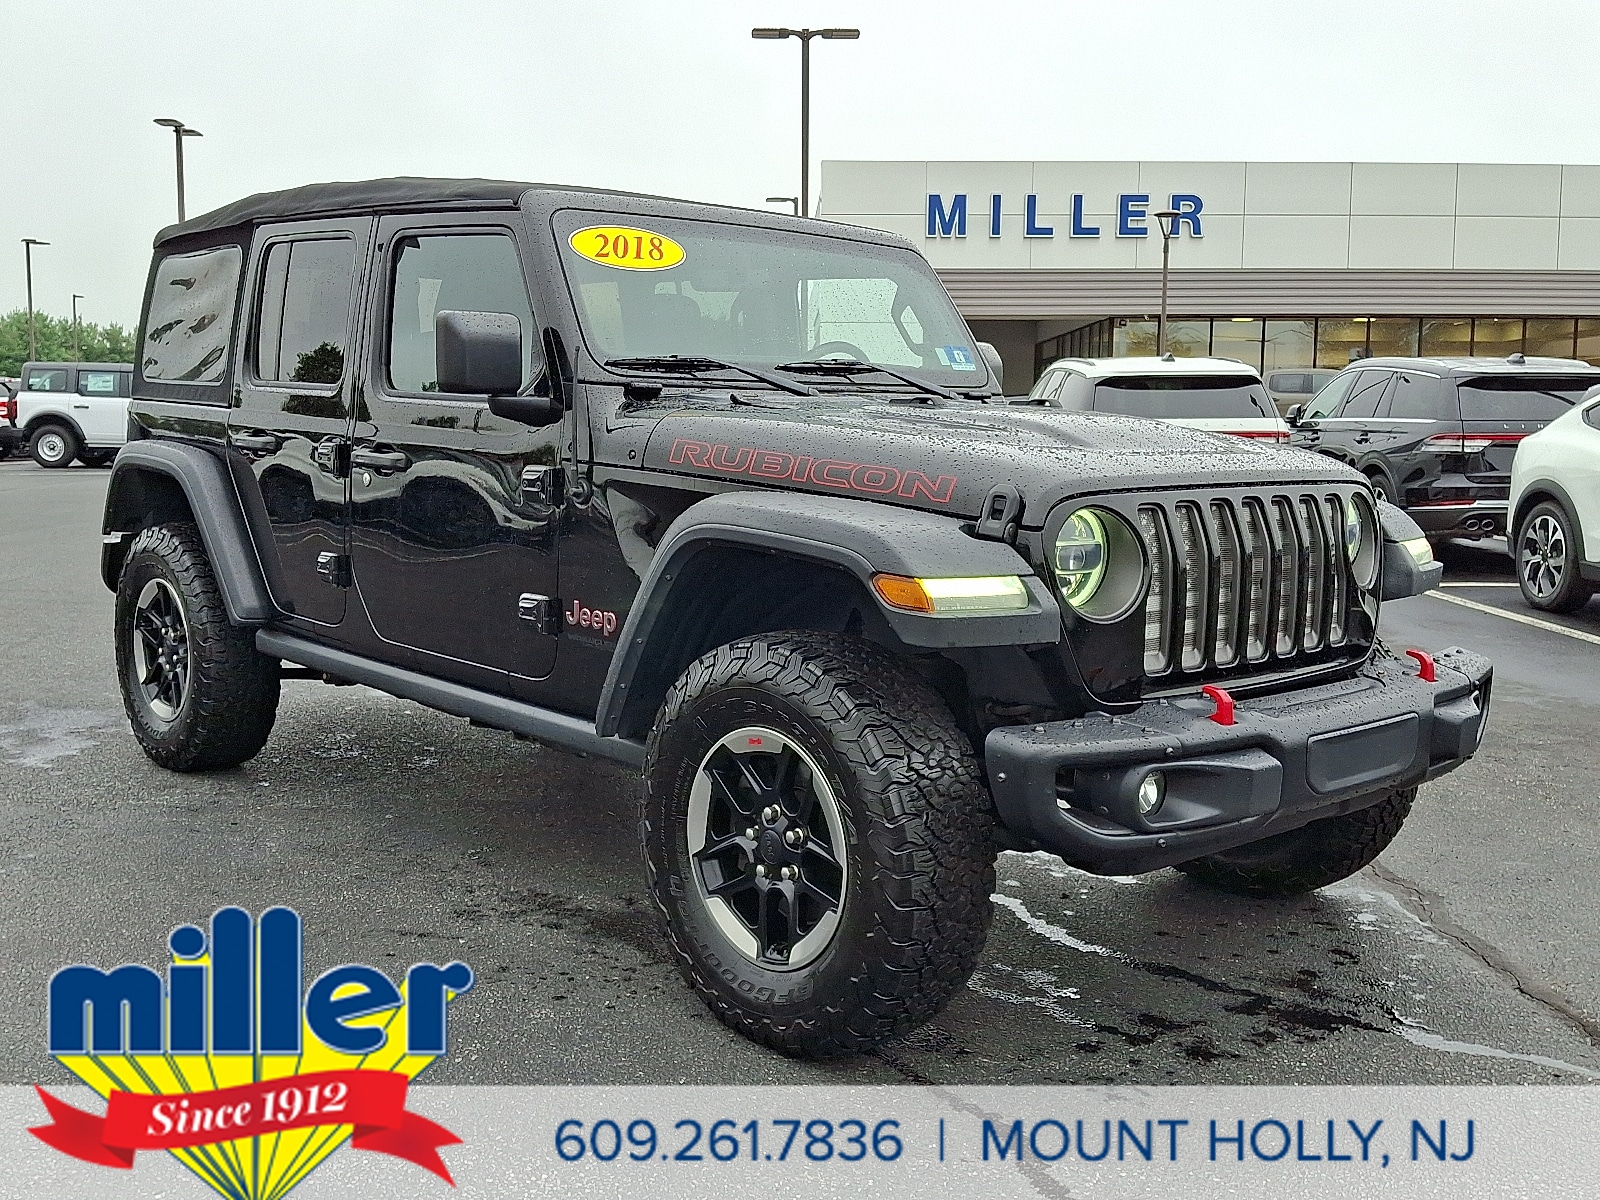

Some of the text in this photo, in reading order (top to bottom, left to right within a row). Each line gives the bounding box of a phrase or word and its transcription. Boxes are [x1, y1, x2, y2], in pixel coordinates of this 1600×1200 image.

[926, 193, 1204, 237] MILLER
[594, 233, 664, 261] 2018
[669, 439, 957, 503] RUBICON
[565, 599, 617, 637] Jeep
